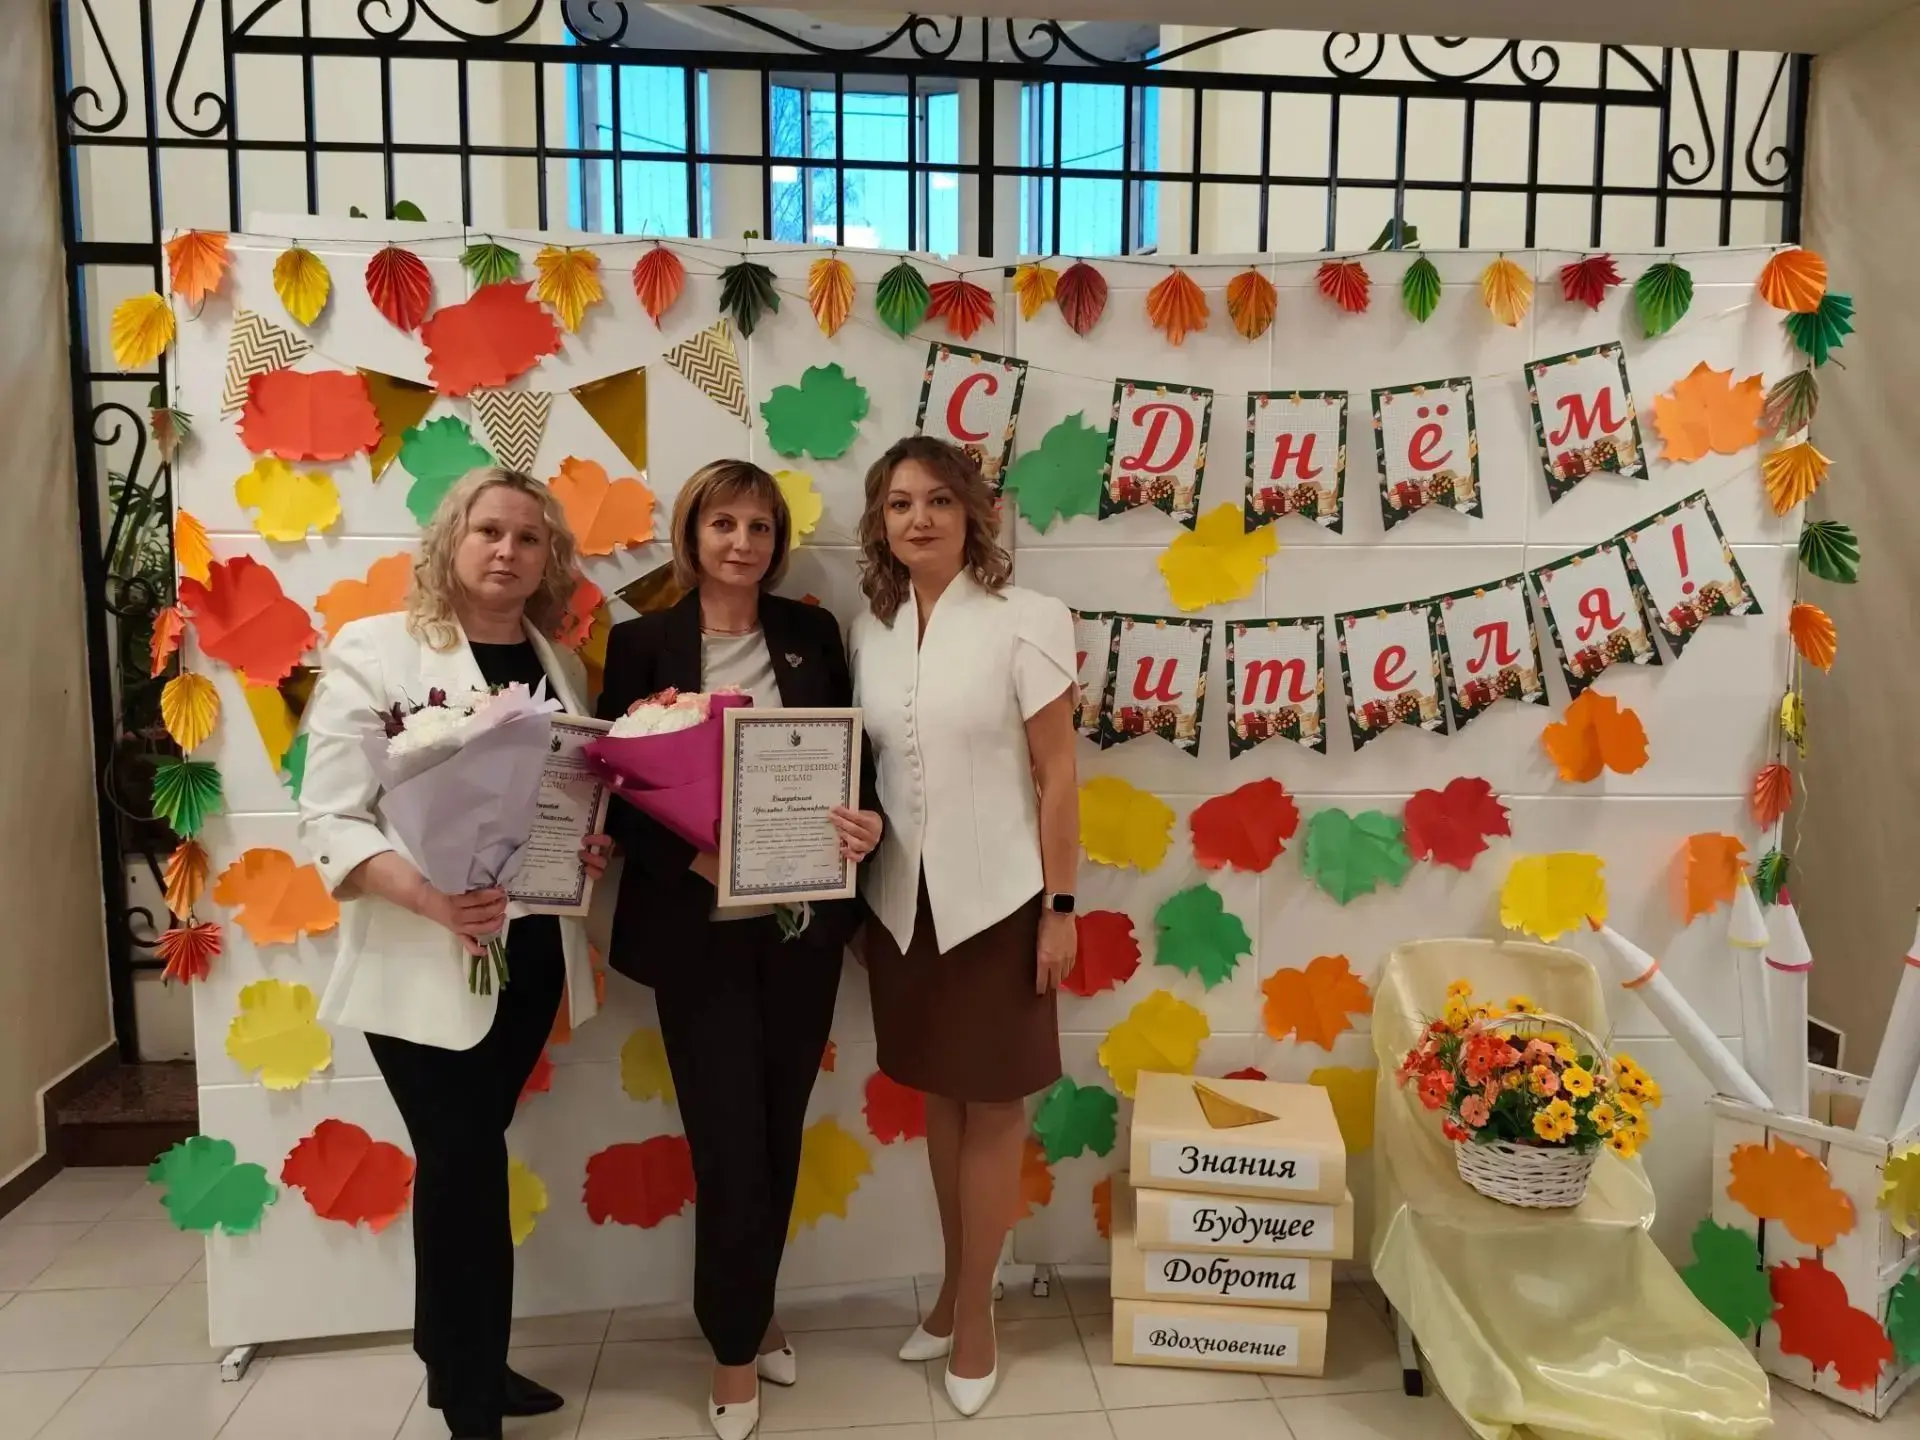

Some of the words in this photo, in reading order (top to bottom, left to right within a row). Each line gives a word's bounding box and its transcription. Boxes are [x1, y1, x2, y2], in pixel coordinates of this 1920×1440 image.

[946, 372, 998, 442] С
[1119, 385, 1627, 480] Днём
[1076, 523, 1695, 706] ителя!
[774, 774, 813, 782] ПИСЬМО
[1178, 1146, 1297, 1178] Знания
[1192, 1206, 1316, 1243] Будущее
[1163, 1257, 1297, 1294] Доброта
[1149, 1328, 1287, 1356] Вдохновение
